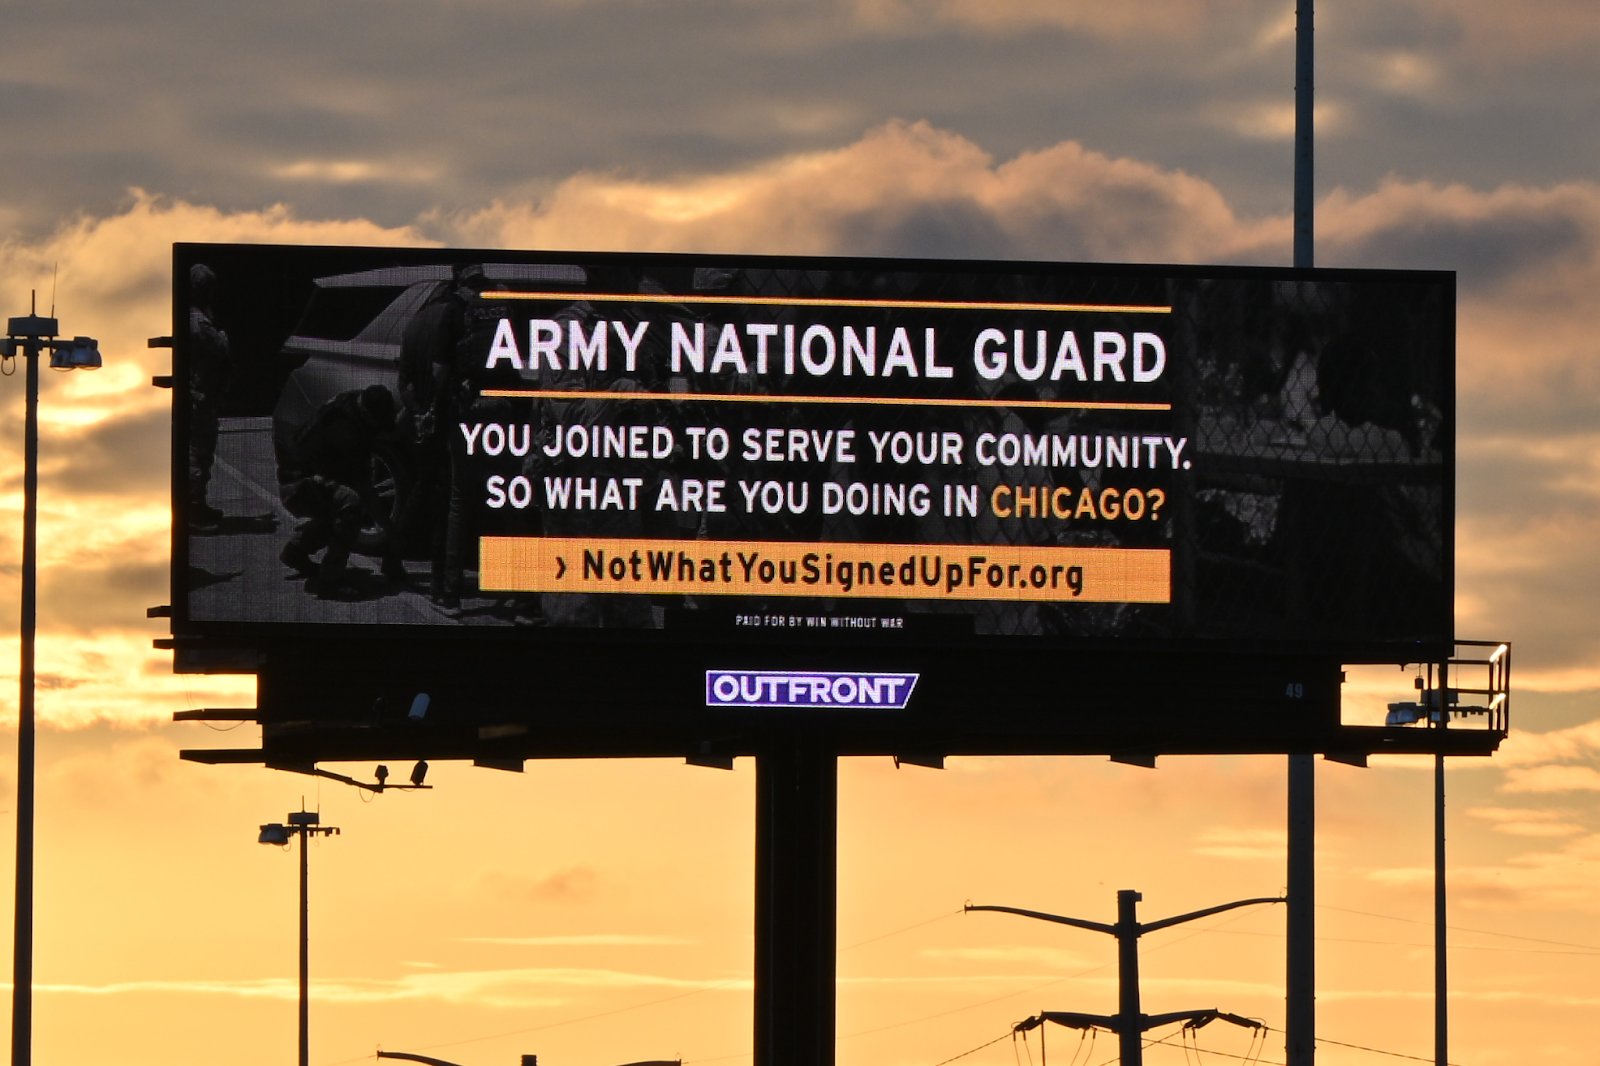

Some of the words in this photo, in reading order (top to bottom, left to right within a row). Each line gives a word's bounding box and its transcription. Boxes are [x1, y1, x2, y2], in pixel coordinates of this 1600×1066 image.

[485, 318, 650, 372] ARMY
[671, 321, 954, 378] NATIONAL
[973, 328, 1166, 383] GUARD
[459, 422, 531, 457] YOU
[542, 424, 674, 459] JOINED
[685, 426, 730, 461] TO
[742, 427, 856, 463] SERVE
[868, 430, 964, 465] YOUR
[975, 432, 1191, 470] COMMUNITY.
[486, 474, 532, 509] SO
[543, 476, 644, 511] WHAT
[655, 478, 727, 513] ARE
[738, 480, 809, 514] YOU
[822, 481, 931, 517] DOING
[943, 484, 978, 518] IN
[991, 484, 1165, 521] CHICAGO?
[583, 549, 1084, 597] NotWhatYouSignedUpFor.org
[735, 614, 761, 627] PAID
[764, 615, 786, 627] FOR
[788, 615, 803, 627] BY
[805, 616, 827, 628] WIN
[830, 616, 877, 628] WITHOUT
[880, 617, 904, 629] WAR
[713, 674, 907, 703] OUTFRONT
[1285, 682, 1304, 699] 49
